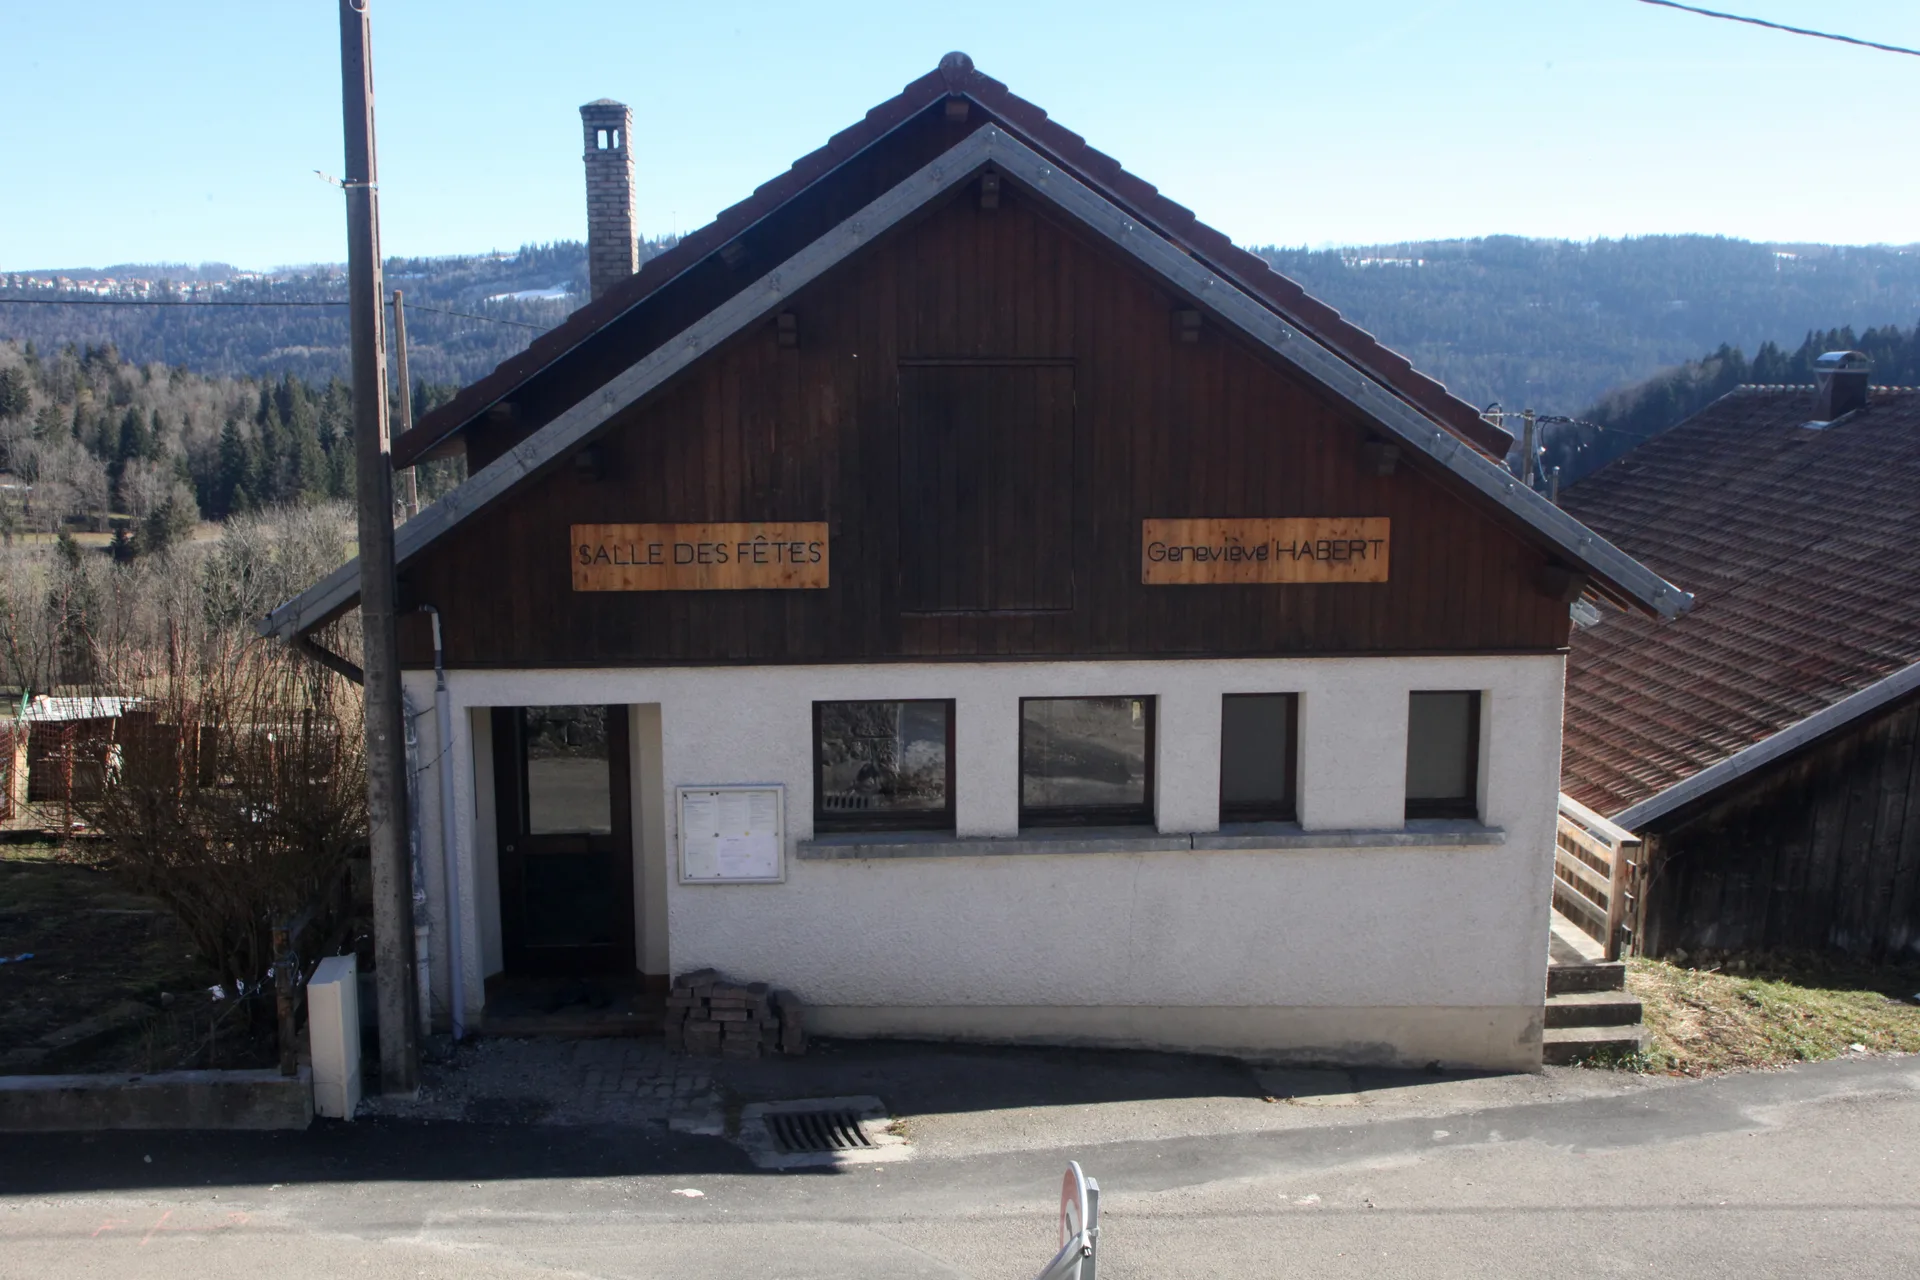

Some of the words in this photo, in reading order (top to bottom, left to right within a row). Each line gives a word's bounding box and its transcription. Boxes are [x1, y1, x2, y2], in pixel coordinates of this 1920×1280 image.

[578, 542, 665, 565] SALLE
[673, 542, 729, 565] DES
[737, 535, 822, 564] FÊTES
[1147, 536, 1269, 562] Geneviève
[1276, 539, 1384, 561] HABERT
